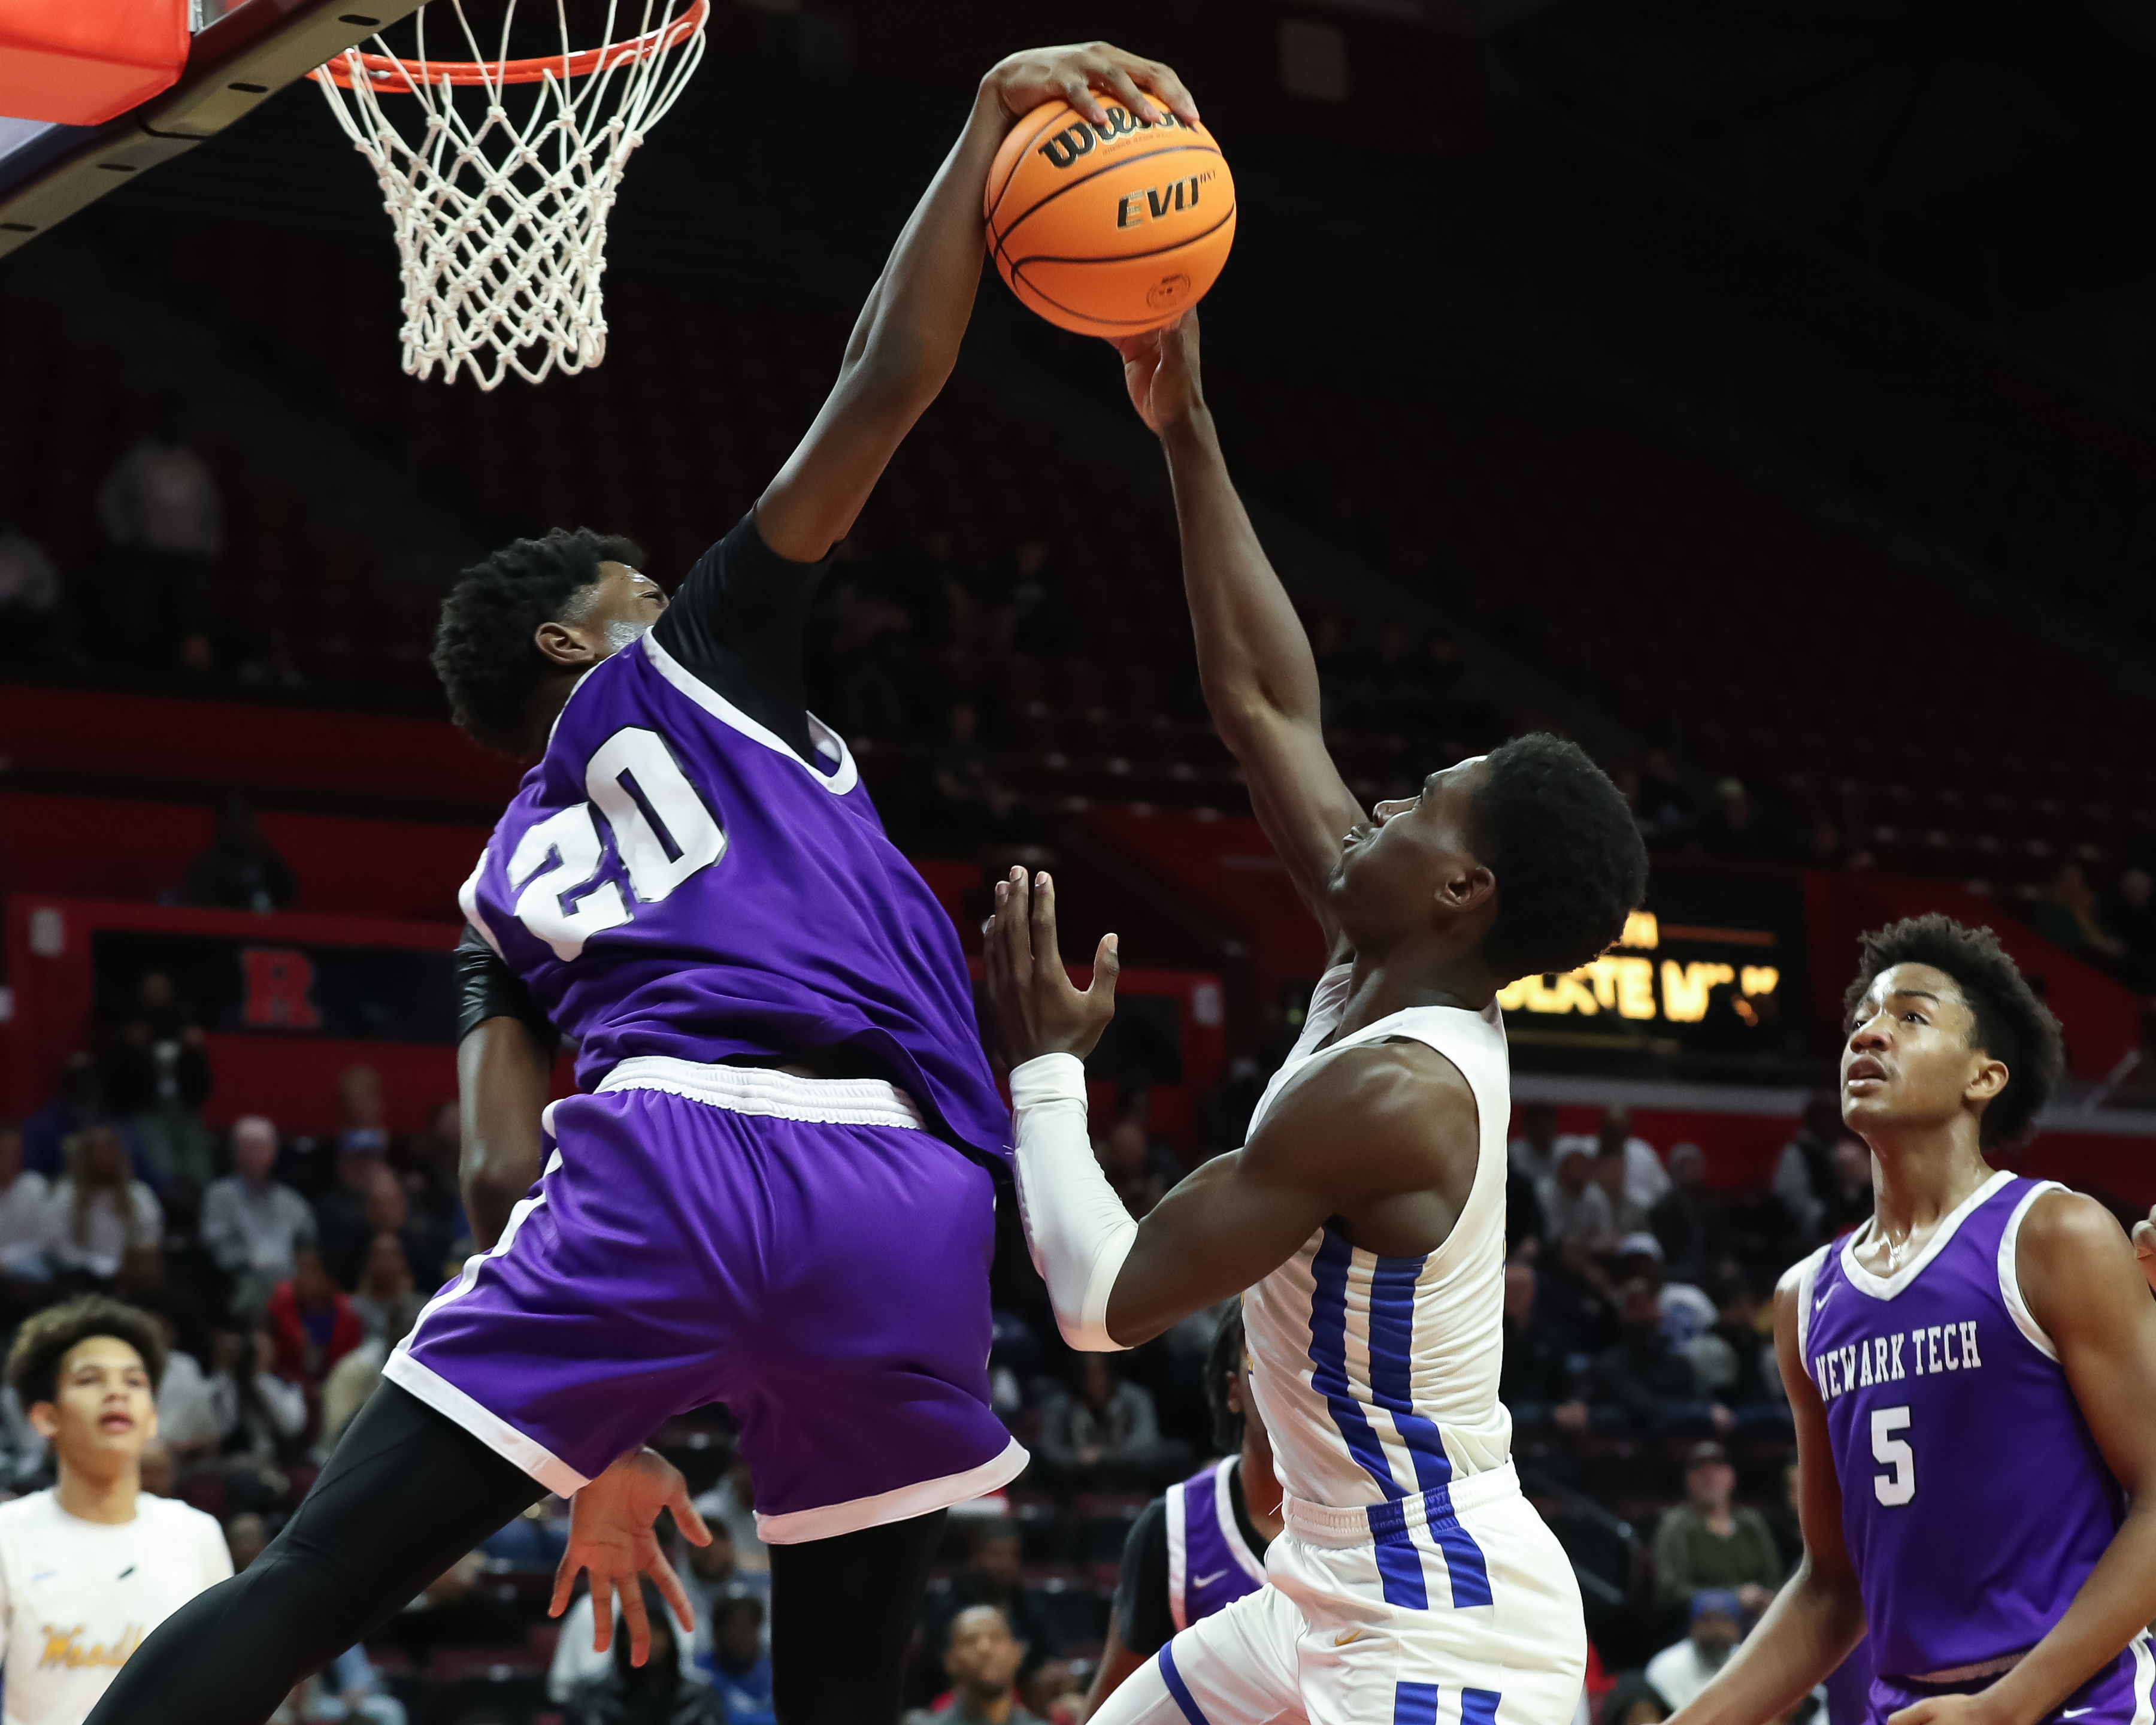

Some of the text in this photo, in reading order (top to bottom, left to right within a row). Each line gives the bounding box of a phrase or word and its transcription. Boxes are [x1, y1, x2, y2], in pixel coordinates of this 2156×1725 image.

[1117, 174, 1198, 229] EVO
[507, 727, 728, 962] 20
[241, 948, 324, 1028] R
[1815, 1320, 1982, 1402] NEWARK TECH
[1871, 1405, 1915, 1506] 5
